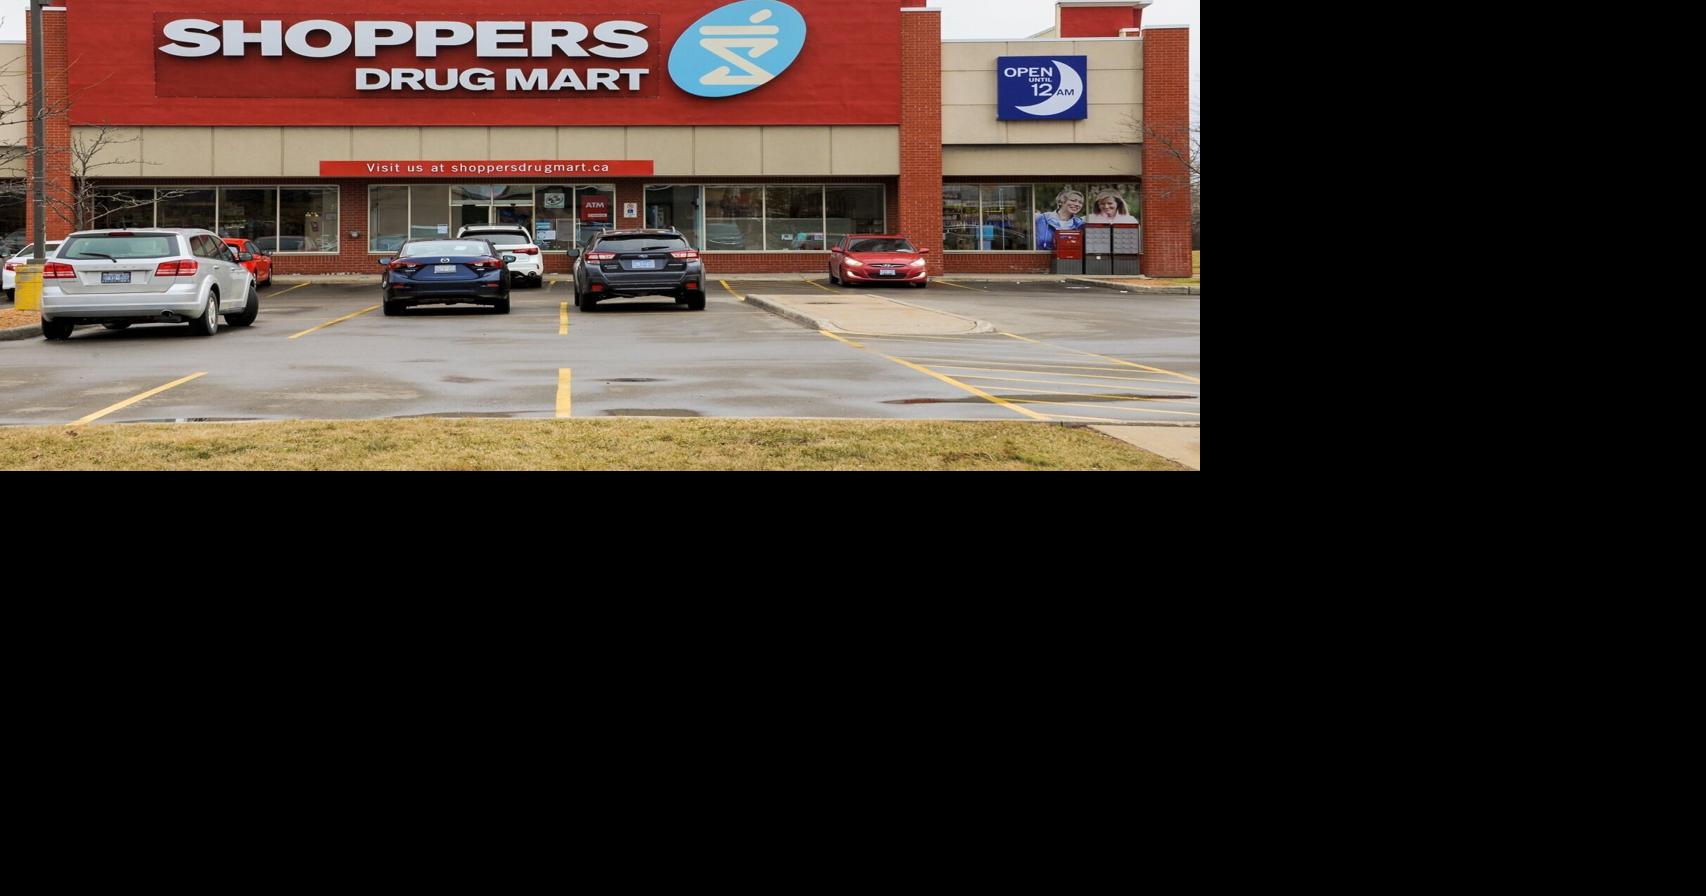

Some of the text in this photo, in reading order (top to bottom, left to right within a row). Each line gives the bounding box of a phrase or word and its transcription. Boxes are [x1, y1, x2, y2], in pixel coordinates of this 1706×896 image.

[158, 19, 649, 58] SHOPPERS
[355, 67, 649, 91] DRUG MART
[1004, 67, 1053, 78] OPEN
[1031, 83, 1075, 97] 12 AM
[366, 163, 400, 172] Visit
[431, 164, 445, 172] at
[451, 163, 609, 174] shoppersdrugmart.ca
